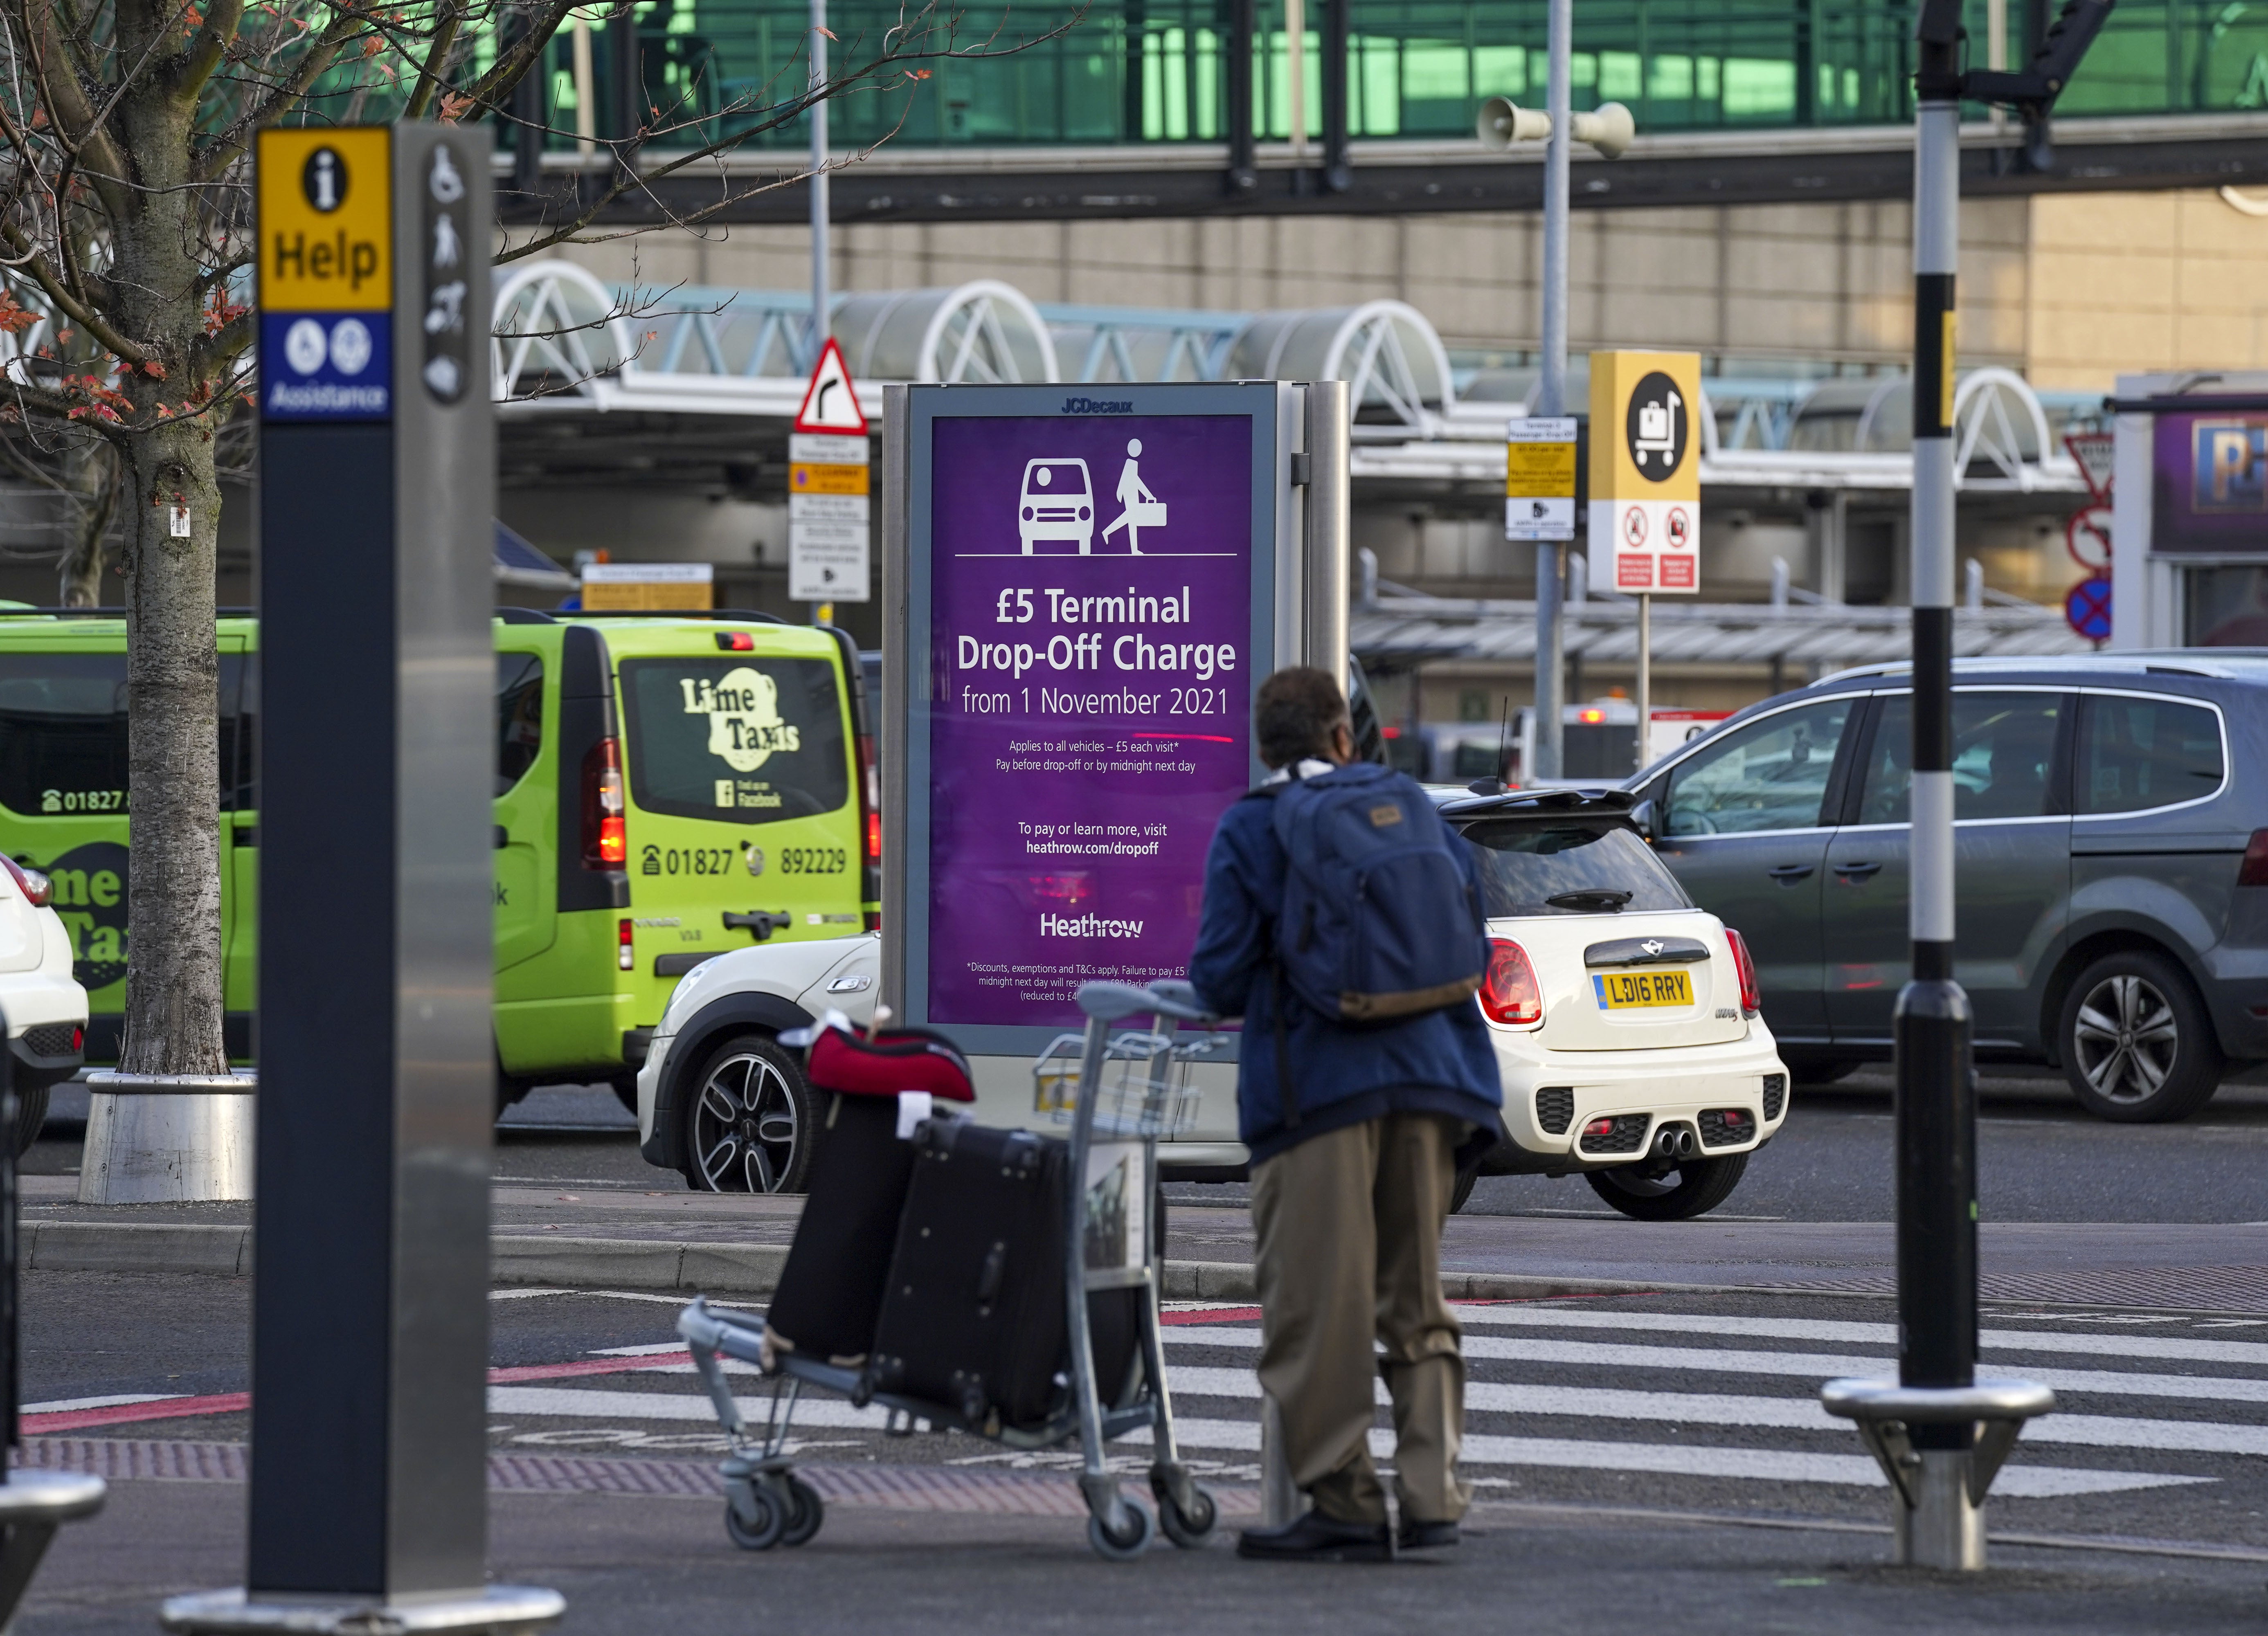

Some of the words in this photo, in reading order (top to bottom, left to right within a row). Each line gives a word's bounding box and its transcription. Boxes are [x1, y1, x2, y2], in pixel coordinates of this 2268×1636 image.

[275, 229, 378, 294] Help
[269, 380, 388, 412] Assistance
[1061, 398, 1133, 413] JCDecaux
[997, 588, 1034, 623] £5
[1044, 586, 1190, 623] Terminal
[958, 633, 1102, 679] Drop-Off
[1113, 634, 1236, 681] Charge
[680, 678, 755, 714] Lime
[962, 685, 1010, 713] from
[1021, 688, 1029, 713] 1
[1042, 686, 1161, 714] November
[1170, 688, 1227, 714] 2021
[726, 717, 801, 752] Taxis
[1009, 739, 1041, 754] Applies
[1044, 742, 1053, 752] to
[1056, 740, 1066, 752] all
[1069, 740, 1105, 752] vehicles
[1116, 741, 1128, 753] £5
[1131, 741, 1152, 753] each
[996, 759, 1010, 773] Pay
[1013, 759, 1041, 771] before
[1044, 759, 1081, 773] drop-off
[1084, 762, 1094, 771] or
[1097, 760, 1108, 773] by
[1111, 760, 1152, 774] midnight
[1155, 762, 1175, 772] next
[1178, 760, 1196, 774] day
[63, 791, 123, 811] 01827
[1018, 822, 1031, 834] To
[1035, 825, 1055, 838] pay
[1058, 825, 1071, 835] or
[1075, 822, 1103, 836] learn
[1107, 826, 1140, 838] more,
[1144, 823, 1167, 836] visit
[667, 849, 733, 875] 01827
[781, 848, 846, 874] 892229
[1026, 840, 1159, 858] heathrow.com/dropoff
[1041, 912, 1143, 938] Heathrow
[979, 976, 1013, 988] midnight
[1015, 978, 1032, 987] next
[1034, 977, 1048, 989] day
[1050, 977, 1064, 987] will
[1066, 978, 1087, 987] result
[1012, 964, 1057, 975] exemptions
[1059, 964, 1073, 974] and
[1076, 964, 1096, 975] T&Cs
[1098, 965, 1120, 977] apply.
[1122, 965, 1146, 975] Failure
[1148, 967, 1157, 975] to
[1159, 969, 1172, 978] pay
[1174, 966, 1185, 976] £5
[1020, 990, 1054, 1001] (reduced
[1057, 992, 1065, 1001] to
[1610, 976, 1651, 1003] LD16
[1653, 975, 1685, 1001] RRY
